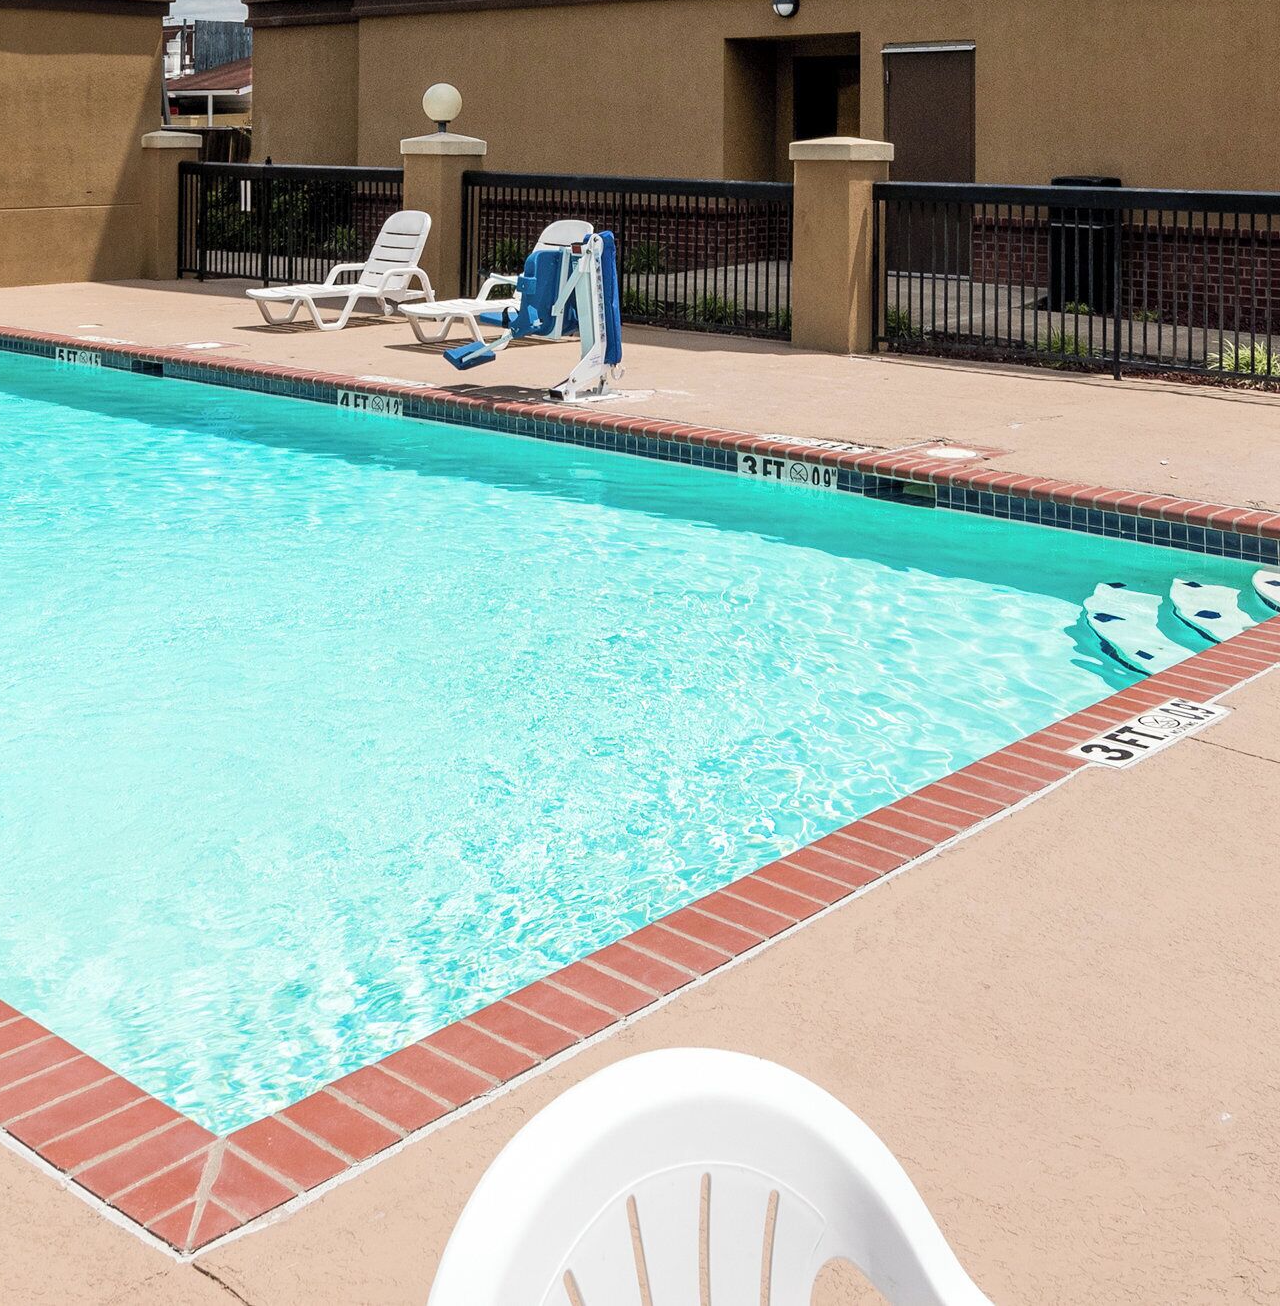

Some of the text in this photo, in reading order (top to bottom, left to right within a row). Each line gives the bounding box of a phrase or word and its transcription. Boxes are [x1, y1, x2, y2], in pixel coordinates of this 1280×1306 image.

[340, 392, 350, 407] 4
[354, 394, 369, 410] FT
[742, 455, 758, 475] 3
[762, 458, 785, 480] FT
[1080, 744, 1134, 761] 3
